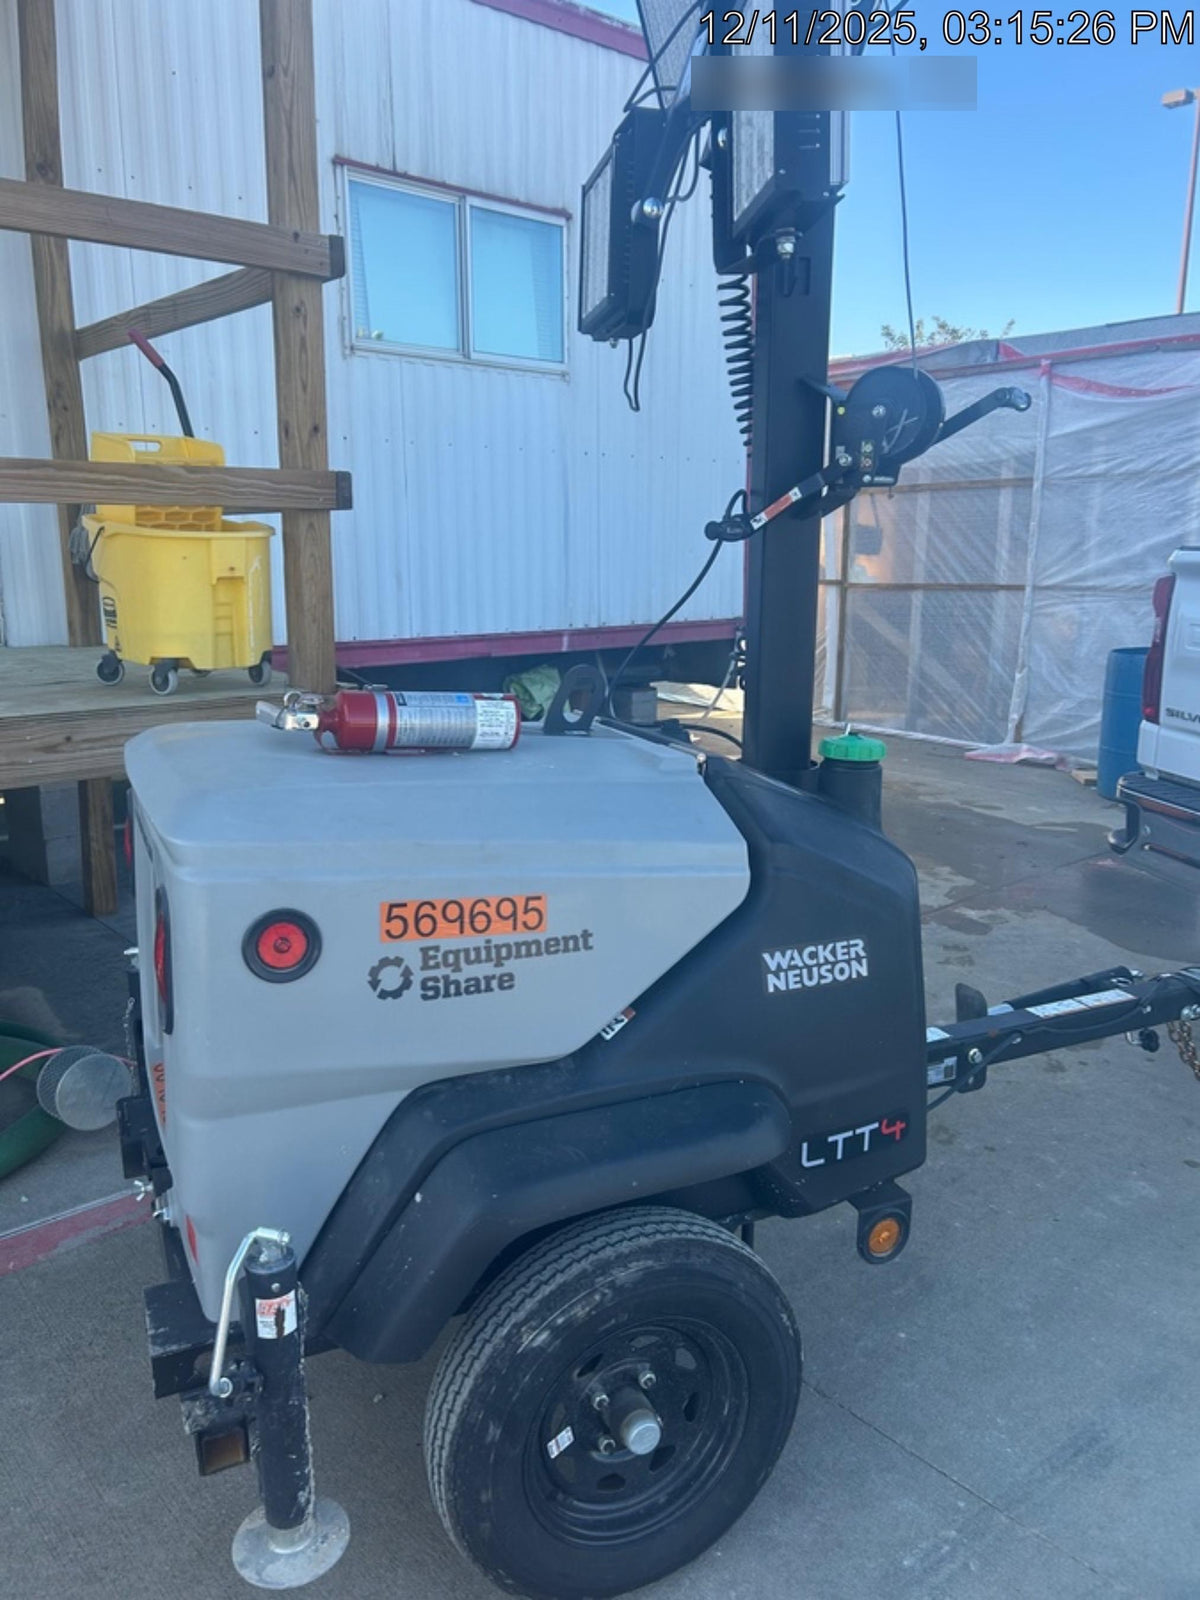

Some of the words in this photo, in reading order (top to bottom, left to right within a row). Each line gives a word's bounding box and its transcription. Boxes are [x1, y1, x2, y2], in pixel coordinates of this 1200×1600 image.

[1166, 707, 1200, 723] SILV
[384, 895, 545, 940] 569695
[419, 929, 594, 974] Equipment
[762, 938, 867, 972] WACKER
[419, 971, 515, 1001] Share
[766, 958, 869, 993] NEUSON
[801, 1119, 906, 1168] LTT4
